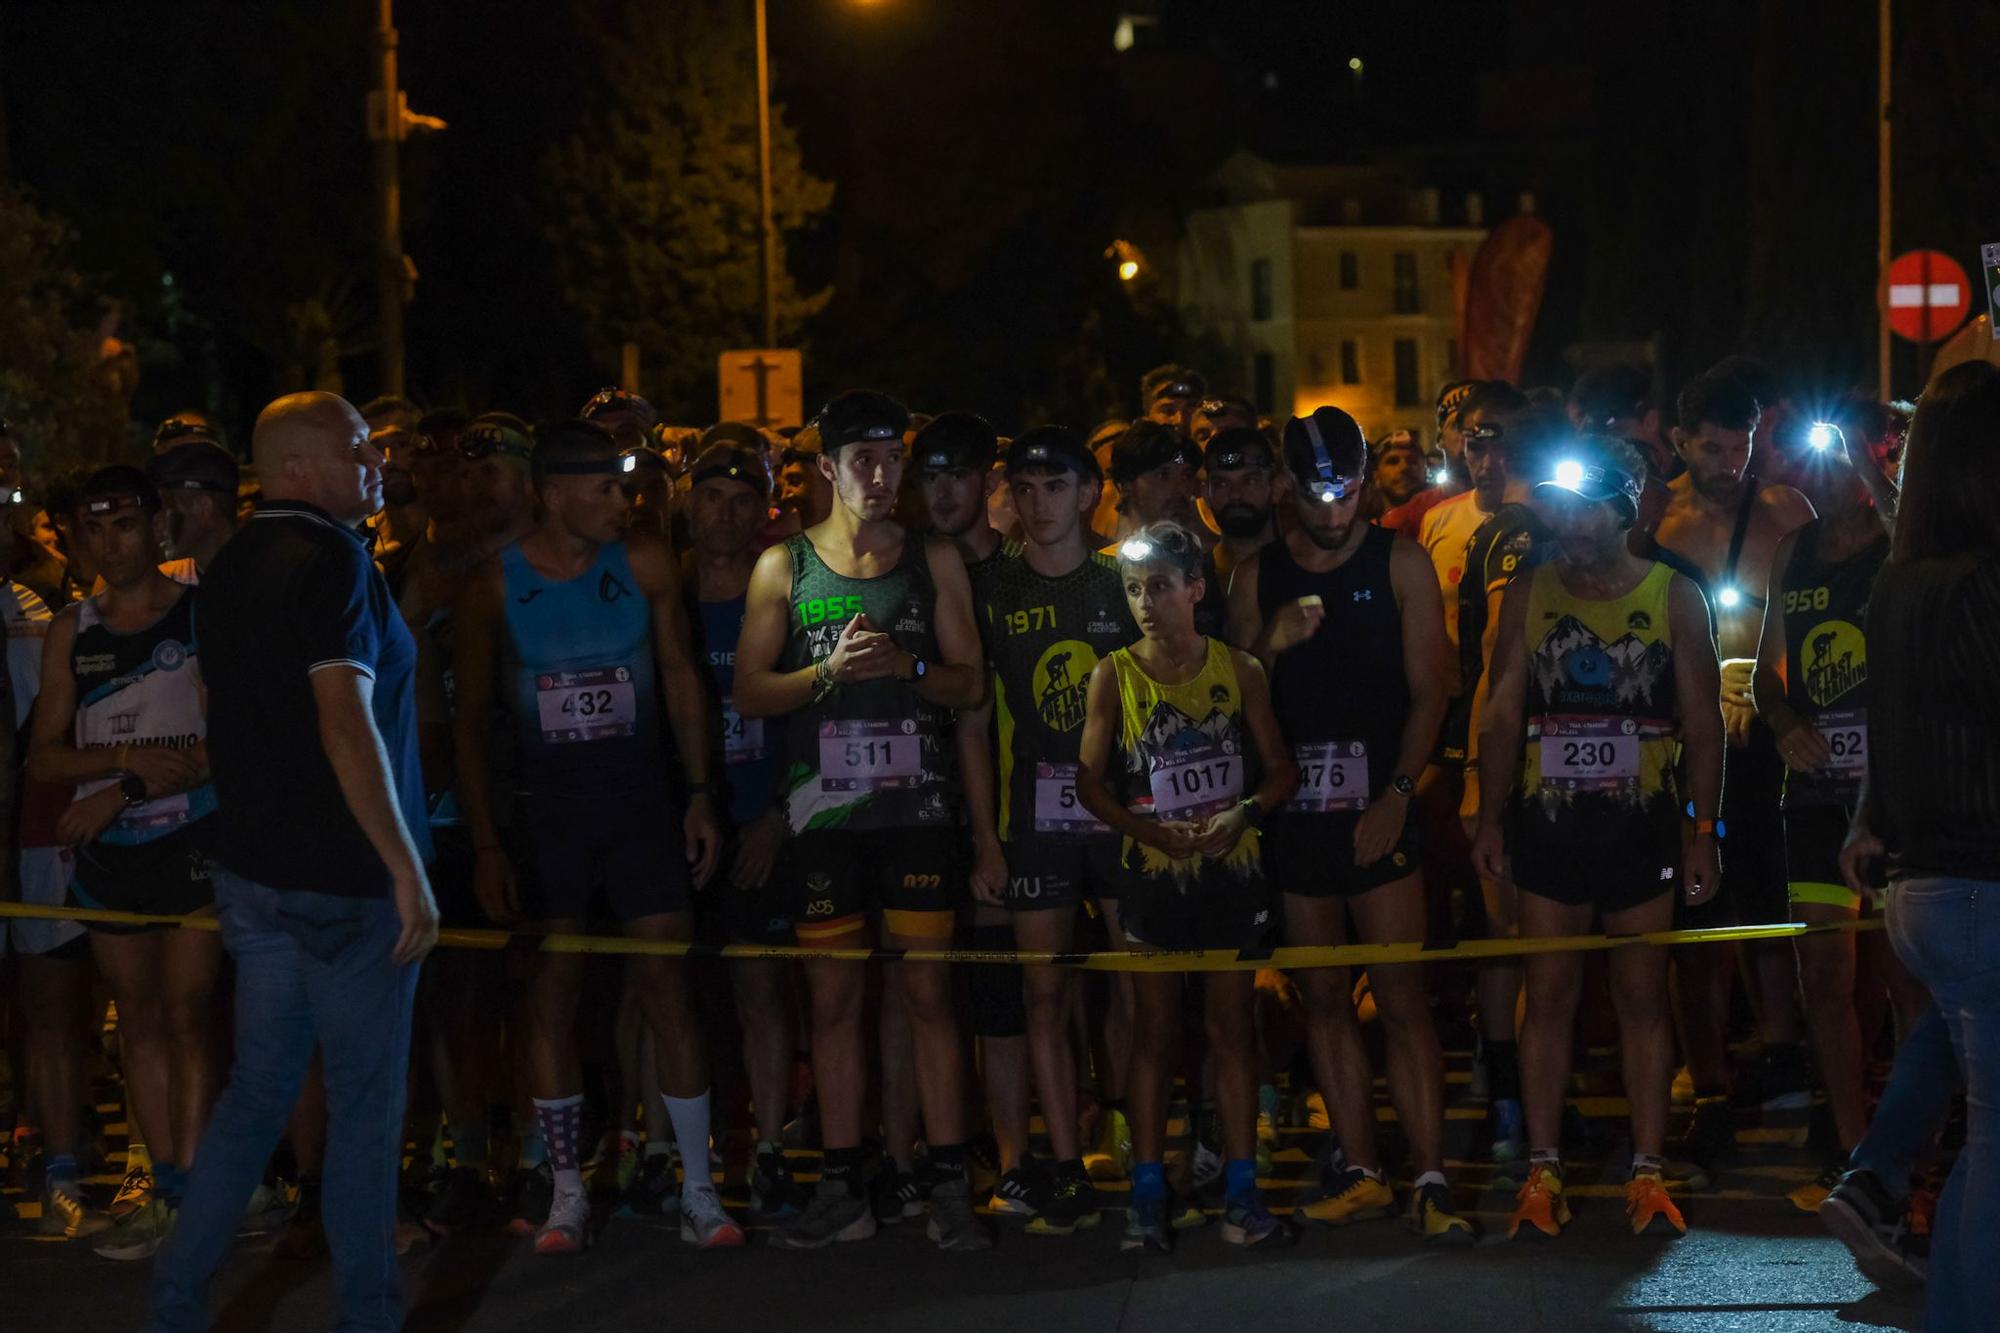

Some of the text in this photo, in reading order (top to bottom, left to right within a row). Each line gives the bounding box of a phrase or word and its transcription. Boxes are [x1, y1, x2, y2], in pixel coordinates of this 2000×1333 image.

[798, 595, 864, 626] 1955
[1004, 604, 1058, 636] 1971
[561, 689, 614, 717] 432
[845, 741, 892, 767] 511
[1563, 741, 1616, 767] 230
[1167, 761, 1231, 797] 1017
[1299, 763, 1345, 788] 476
[1008, 876, 1041, 899] YU
